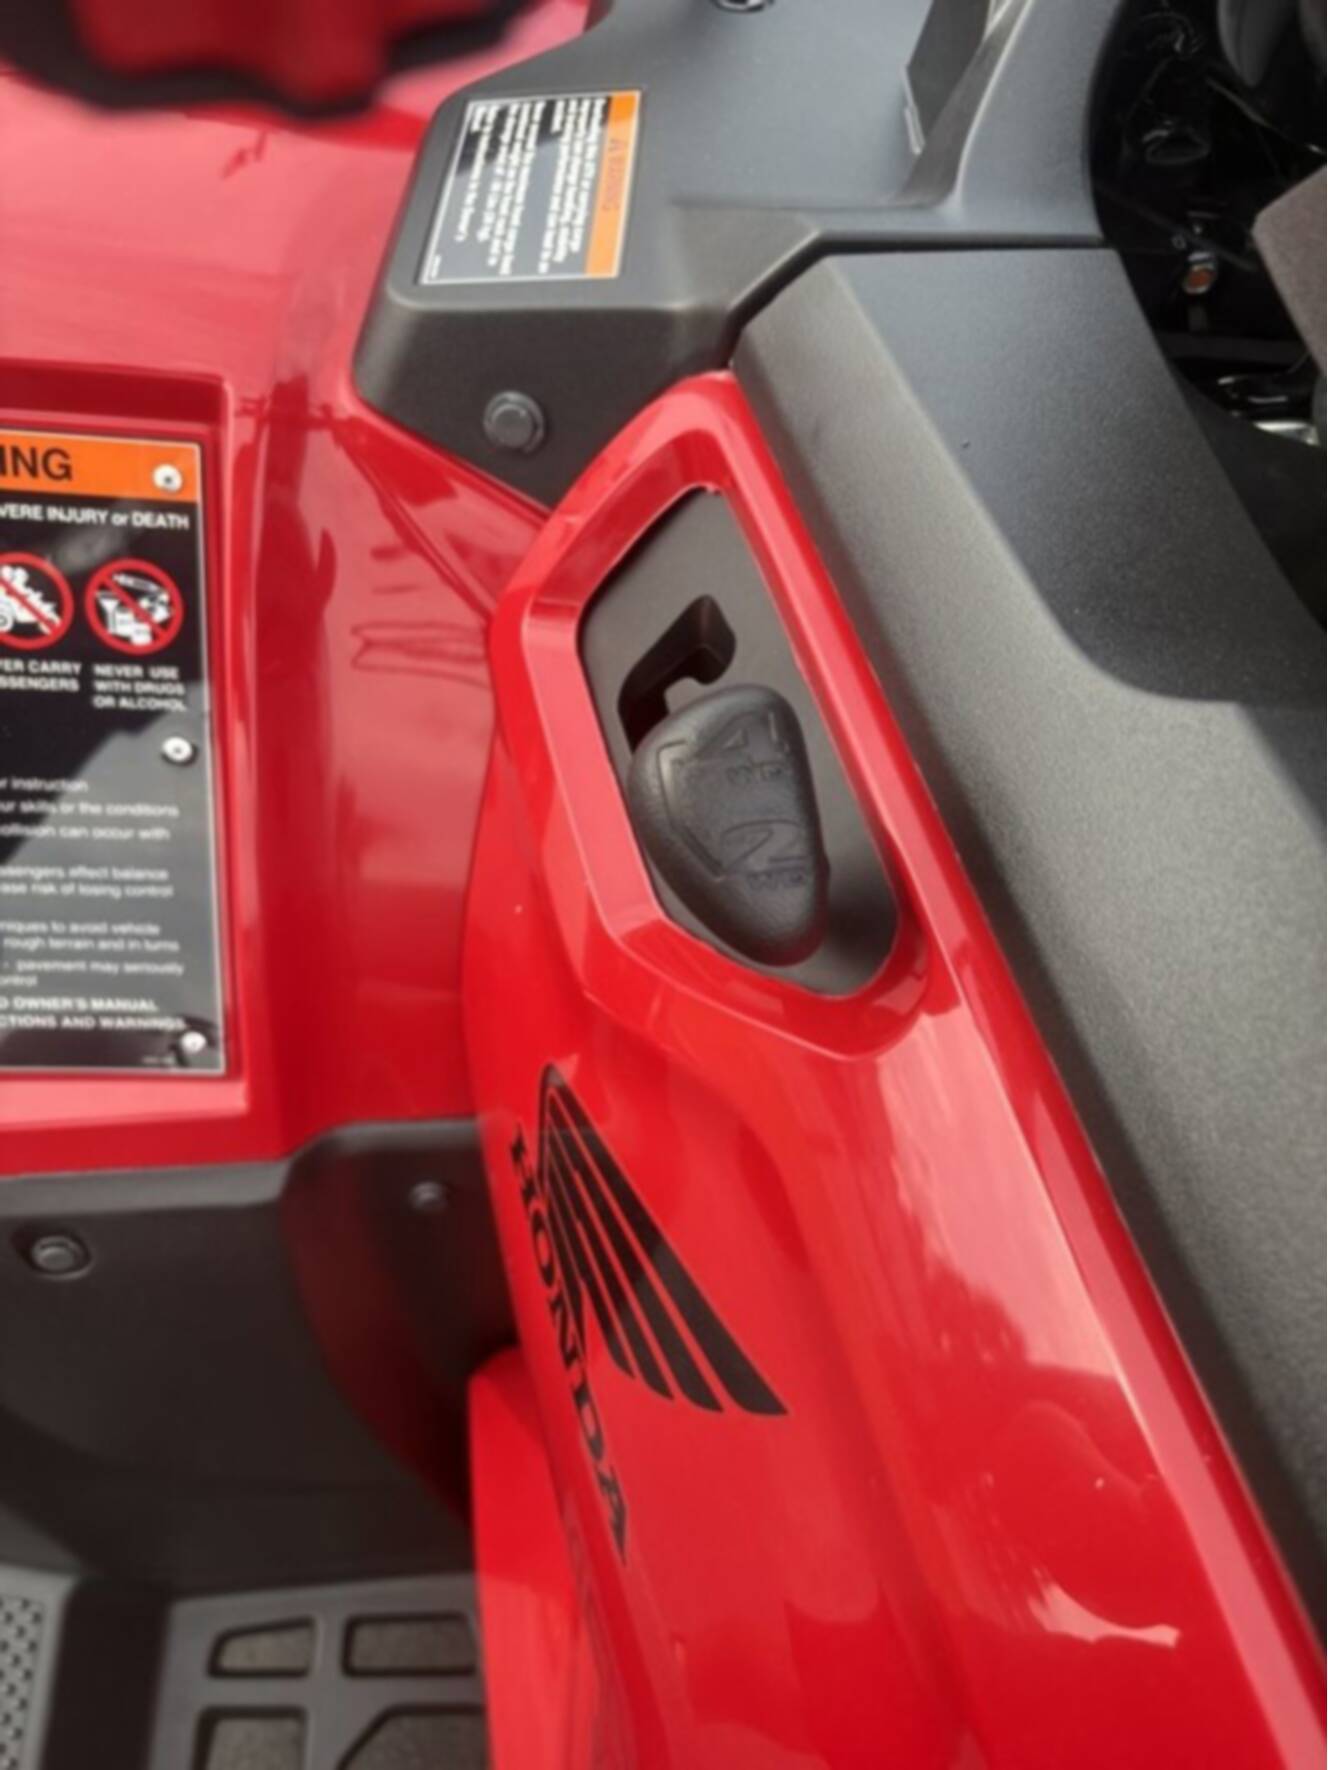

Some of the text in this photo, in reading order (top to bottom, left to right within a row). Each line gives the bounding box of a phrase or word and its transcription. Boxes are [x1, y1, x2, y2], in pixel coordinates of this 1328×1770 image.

[47, 508, 108, 525] INJURY
[111, 513, 129, 526] or
[131, 511, 189, 529] DEATH
[28, 661, 82, 675] CARRY
[93, 664, 179, 681] NEVER USE
[93, 679, 185, 695] WITH DRUGS
[92, 695, 187, 712] OR ALCOHOL
[11, 777, 88, 791] instruction
[78, 801, 102, 815] the
[105, 803, 180, 817] conditions
[13, 996, 88, 1011] OWNER'S
[61, 1016, 95, 1030] AND
[510, 1122, 628, 1567] HONDA
